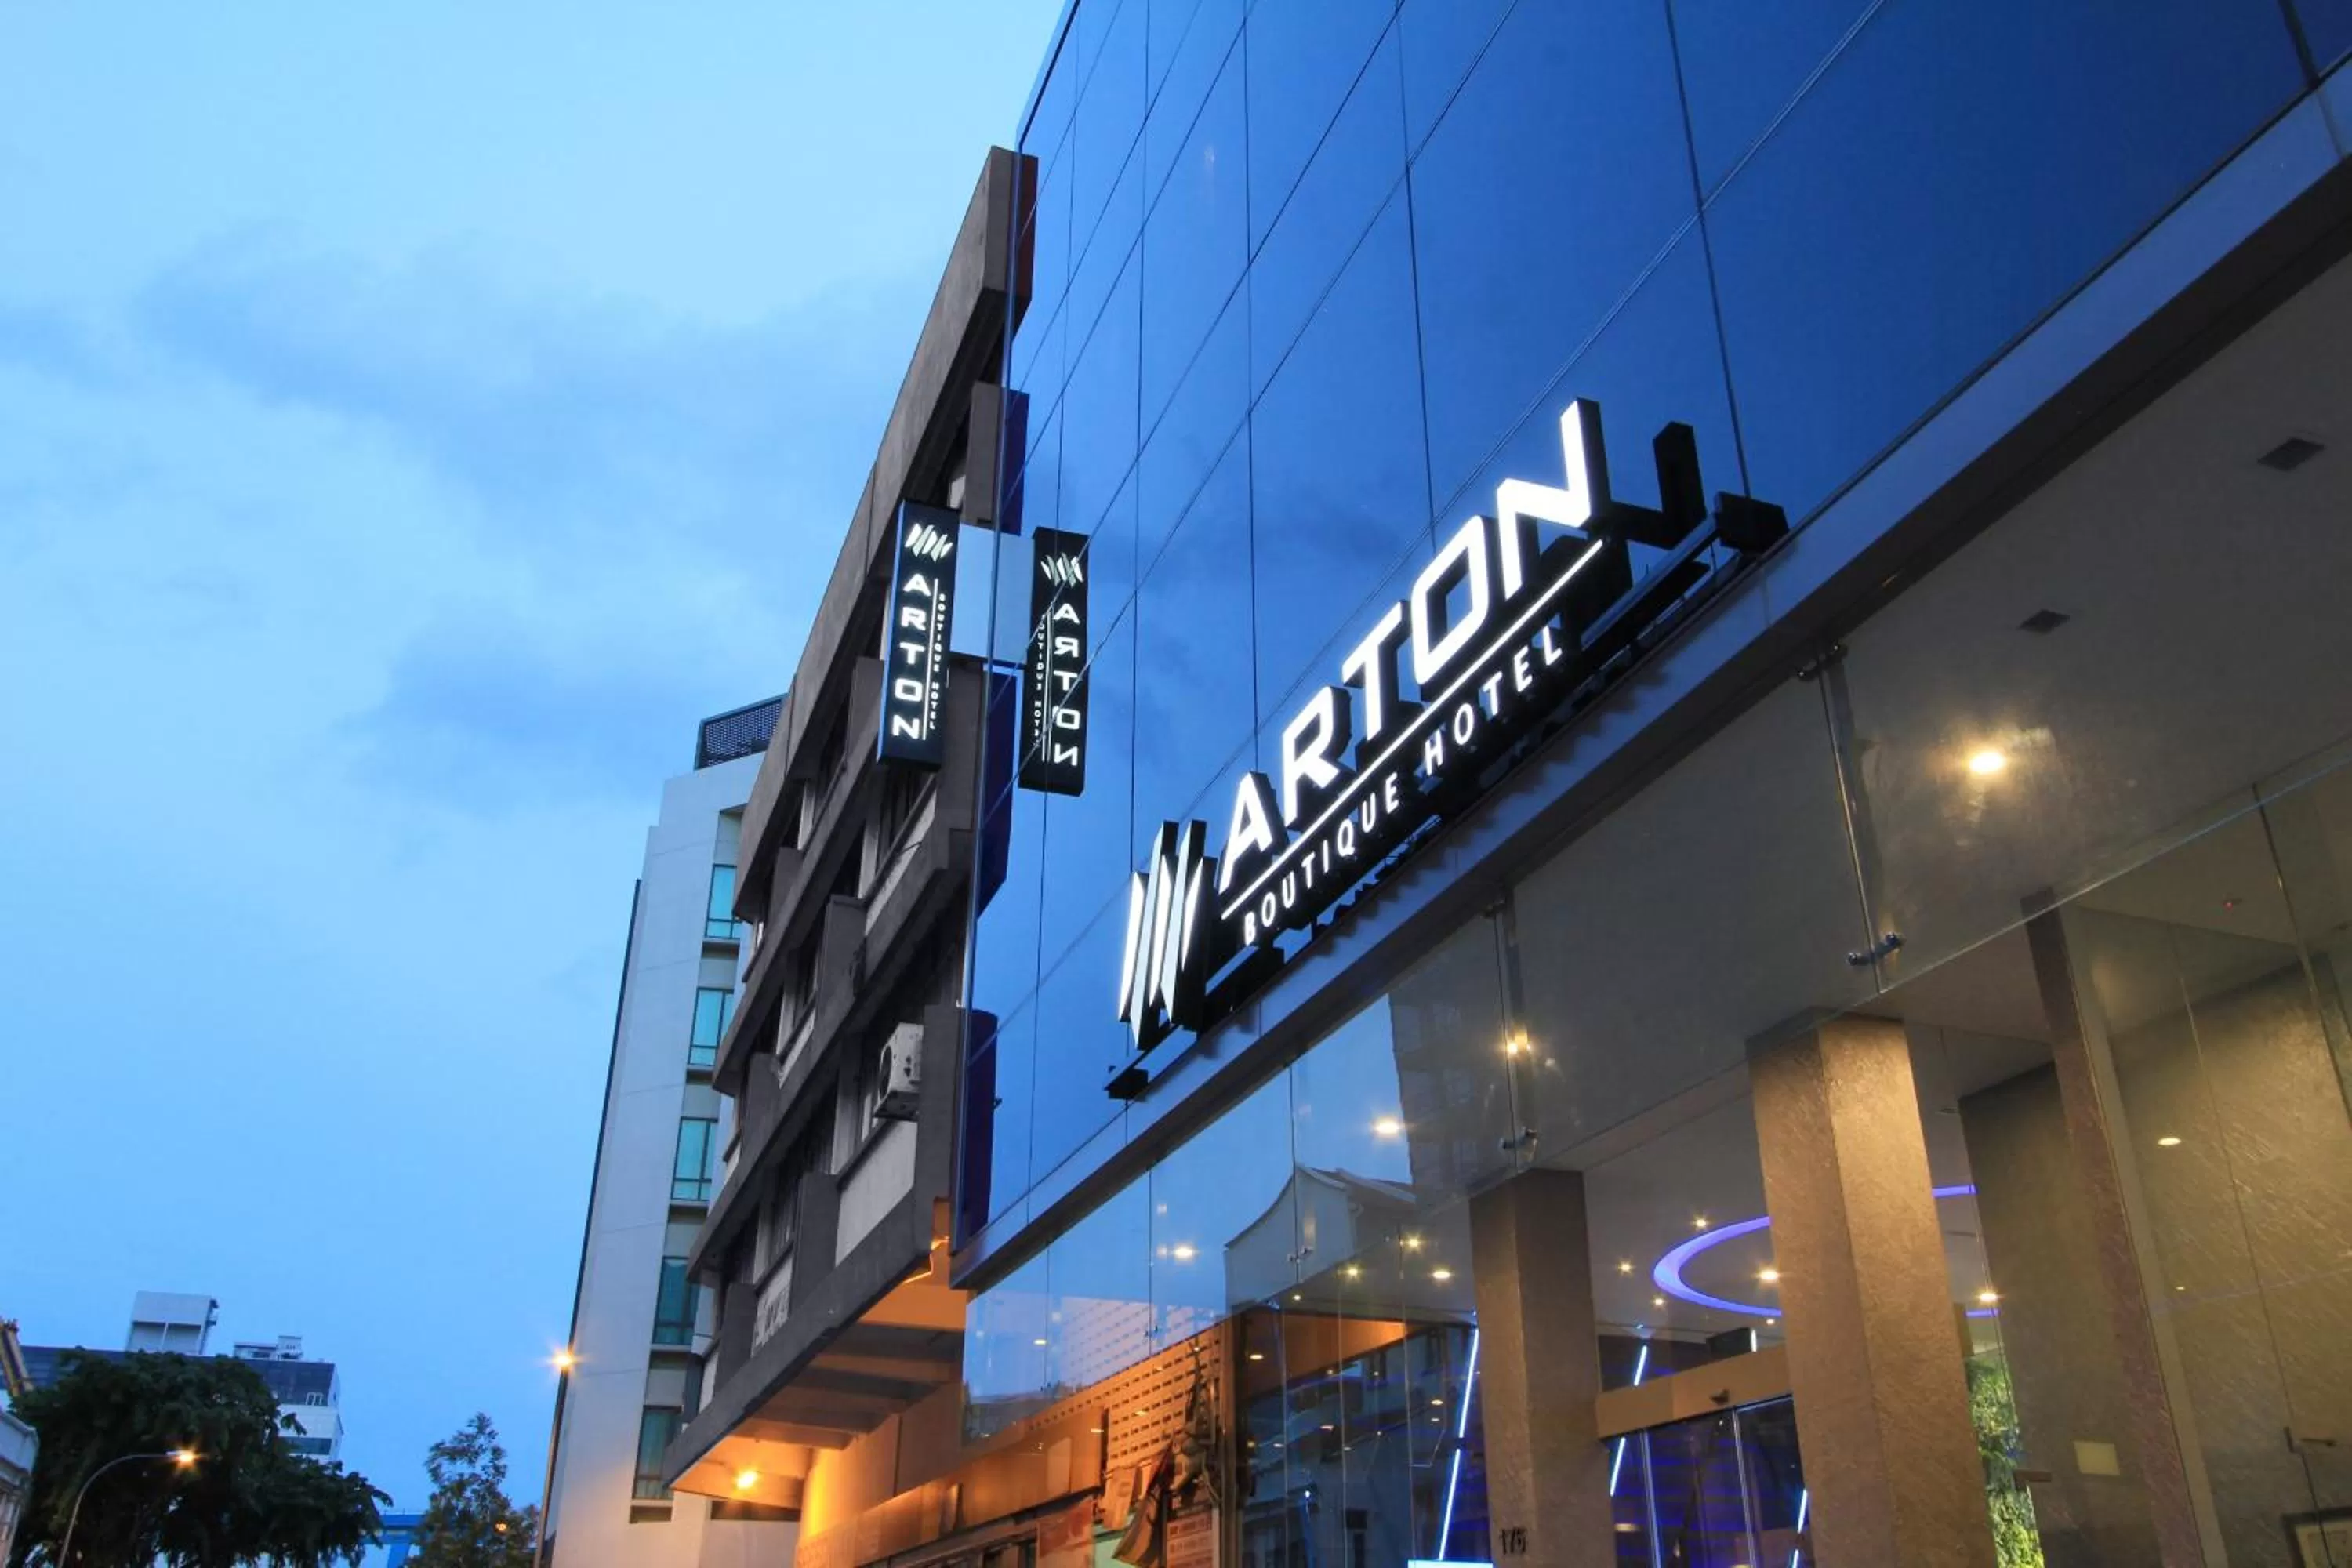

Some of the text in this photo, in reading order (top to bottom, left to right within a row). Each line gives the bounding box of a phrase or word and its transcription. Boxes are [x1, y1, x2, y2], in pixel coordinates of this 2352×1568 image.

[892, 573, 931, 740] ARTON
[929, 593, 946, 730] BOUTIQUE HOTEL
[1219, 398, 1592, 894] ARTON
[1243, 622, 1563, 946] BOUTIQUE HOTEL
